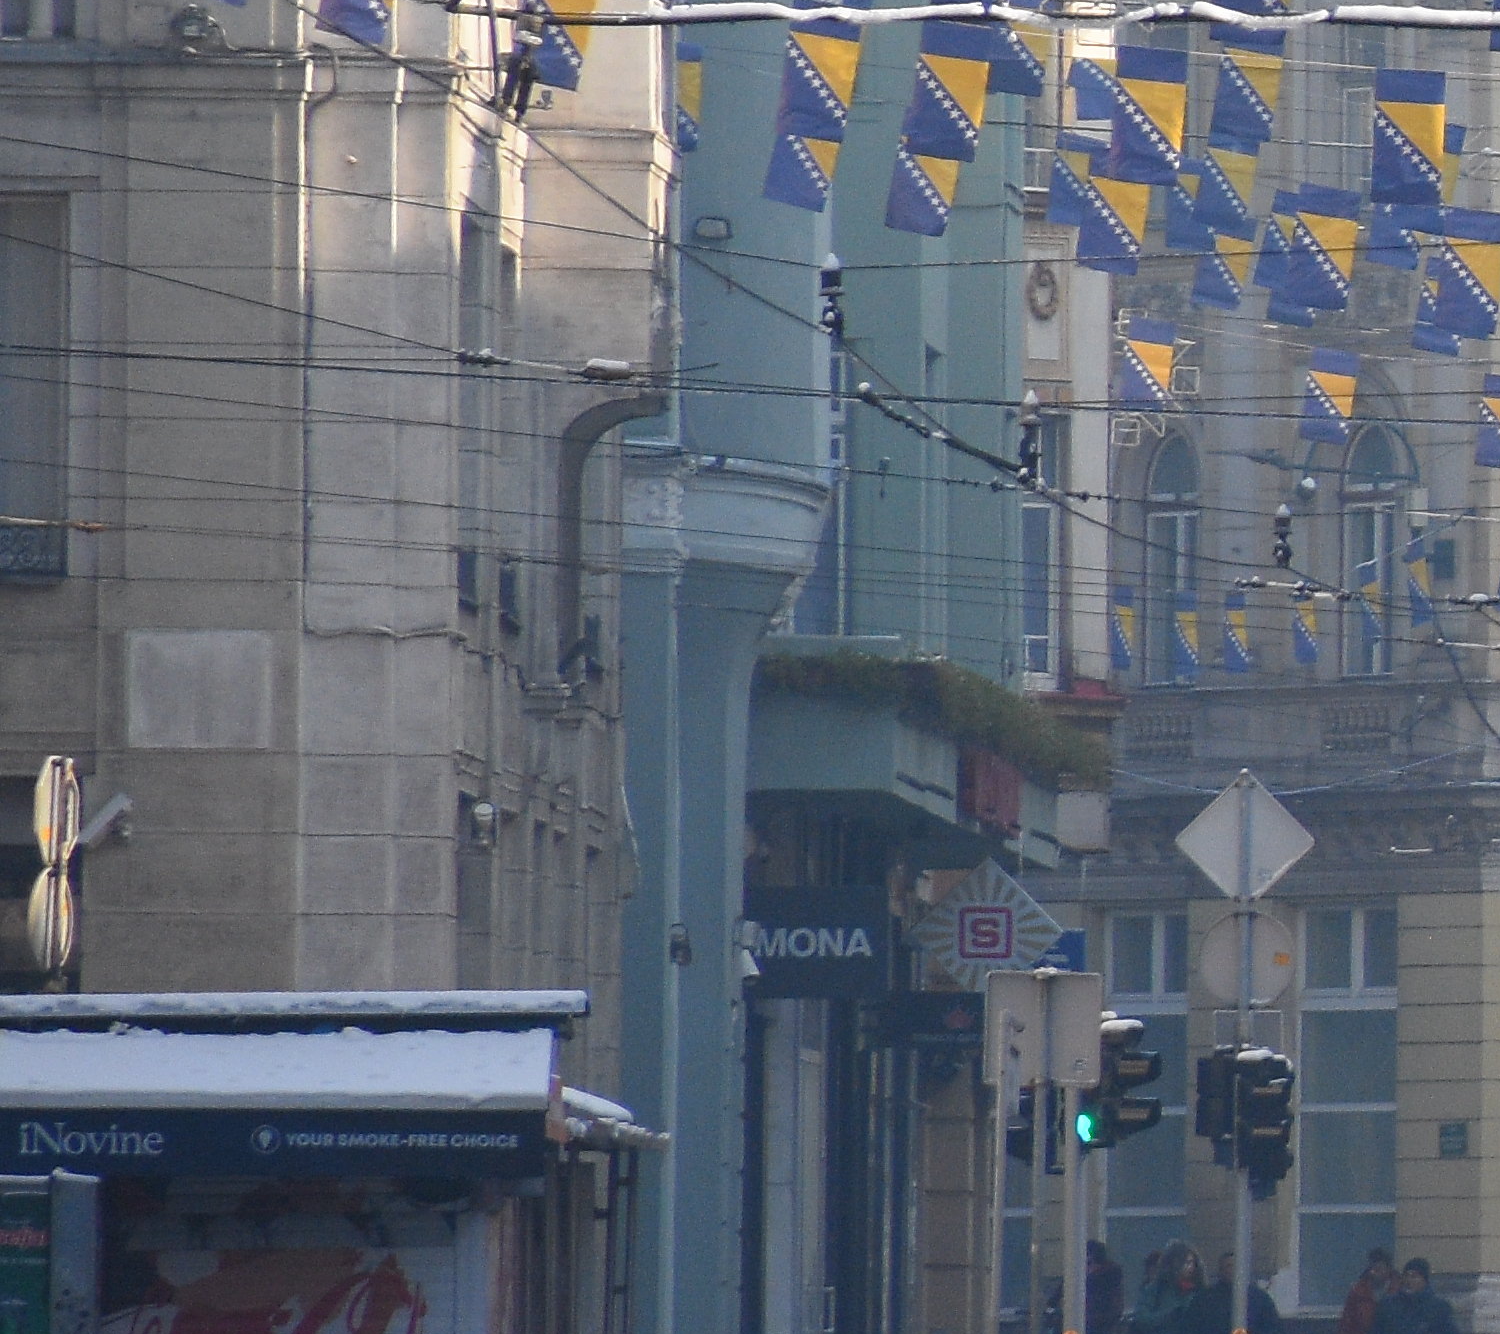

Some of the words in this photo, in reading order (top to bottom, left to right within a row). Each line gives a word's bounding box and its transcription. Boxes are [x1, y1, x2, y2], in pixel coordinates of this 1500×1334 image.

[19, 1121, 164, 1156] iNovine
[286, 1133, 334, 1147] YOUR
[338, 1133, 447, 1147] SMOKE-FREE
[450, 1133, 518, 1148] CHOICE
